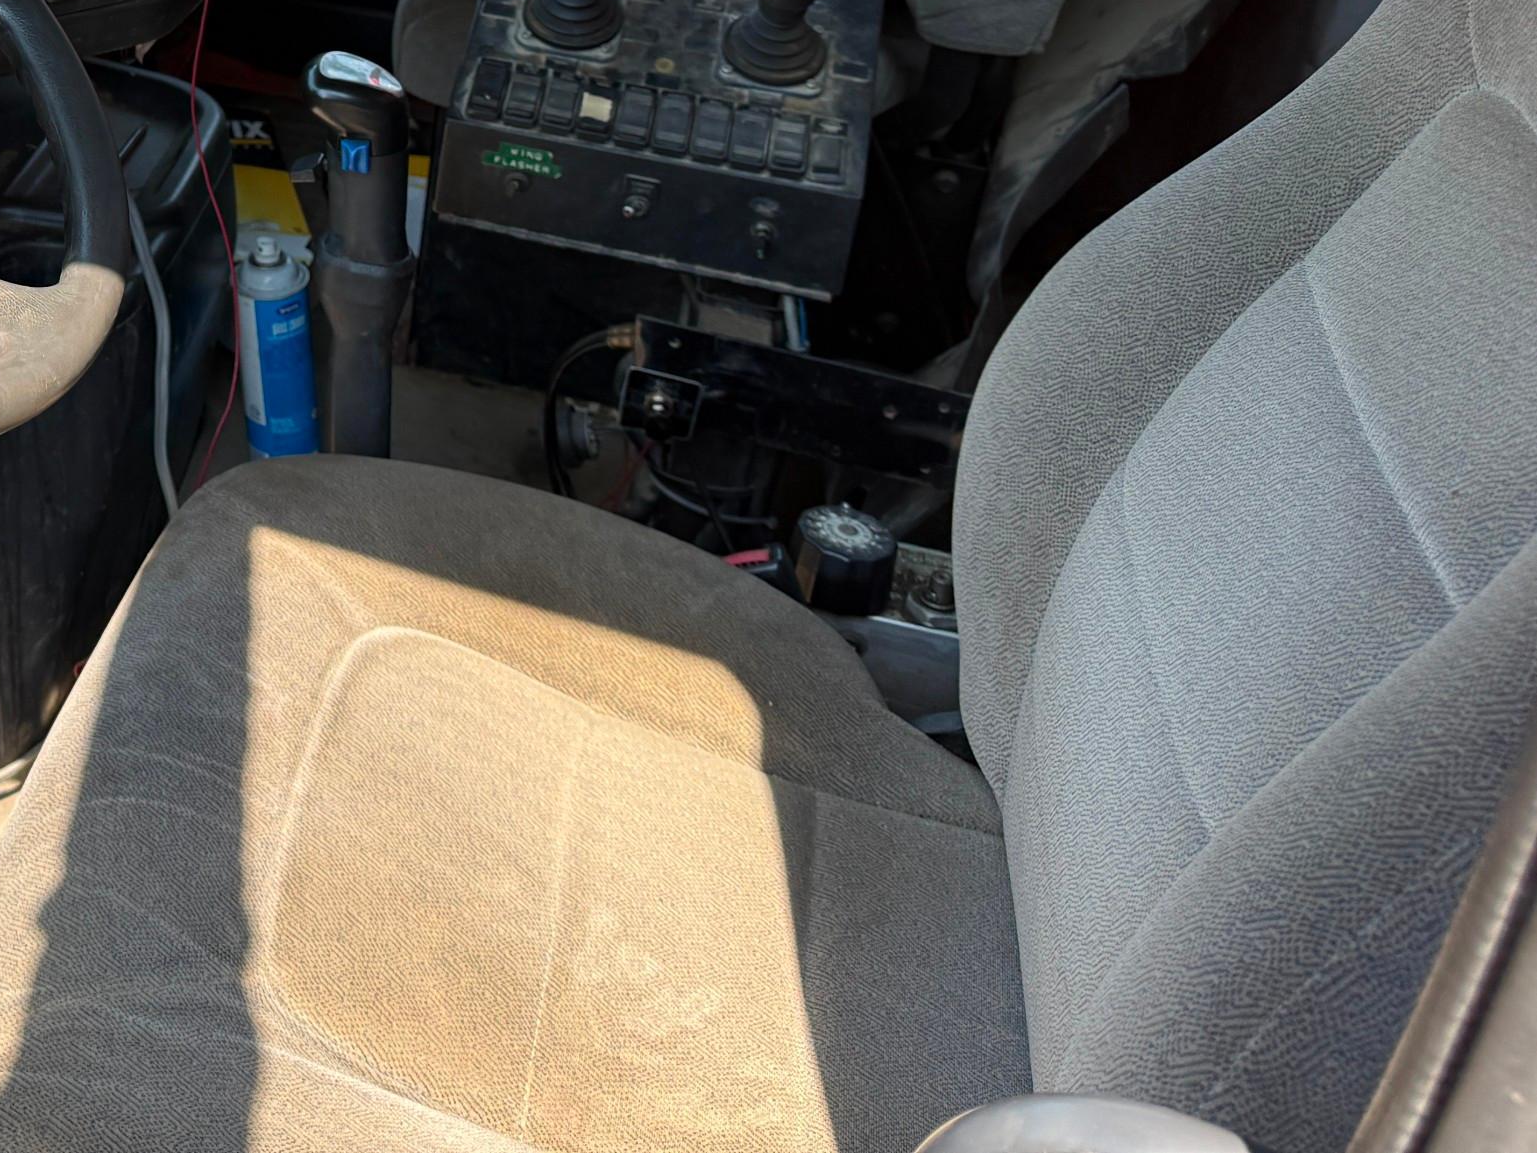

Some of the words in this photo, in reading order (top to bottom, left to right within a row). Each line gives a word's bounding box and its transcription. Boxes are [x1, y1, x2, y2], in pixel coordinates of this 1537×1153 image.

[226, 120, 271, 139] IX
[493, 155, 551, 174] FLASHER
[510, 148, 544, 162] WING
